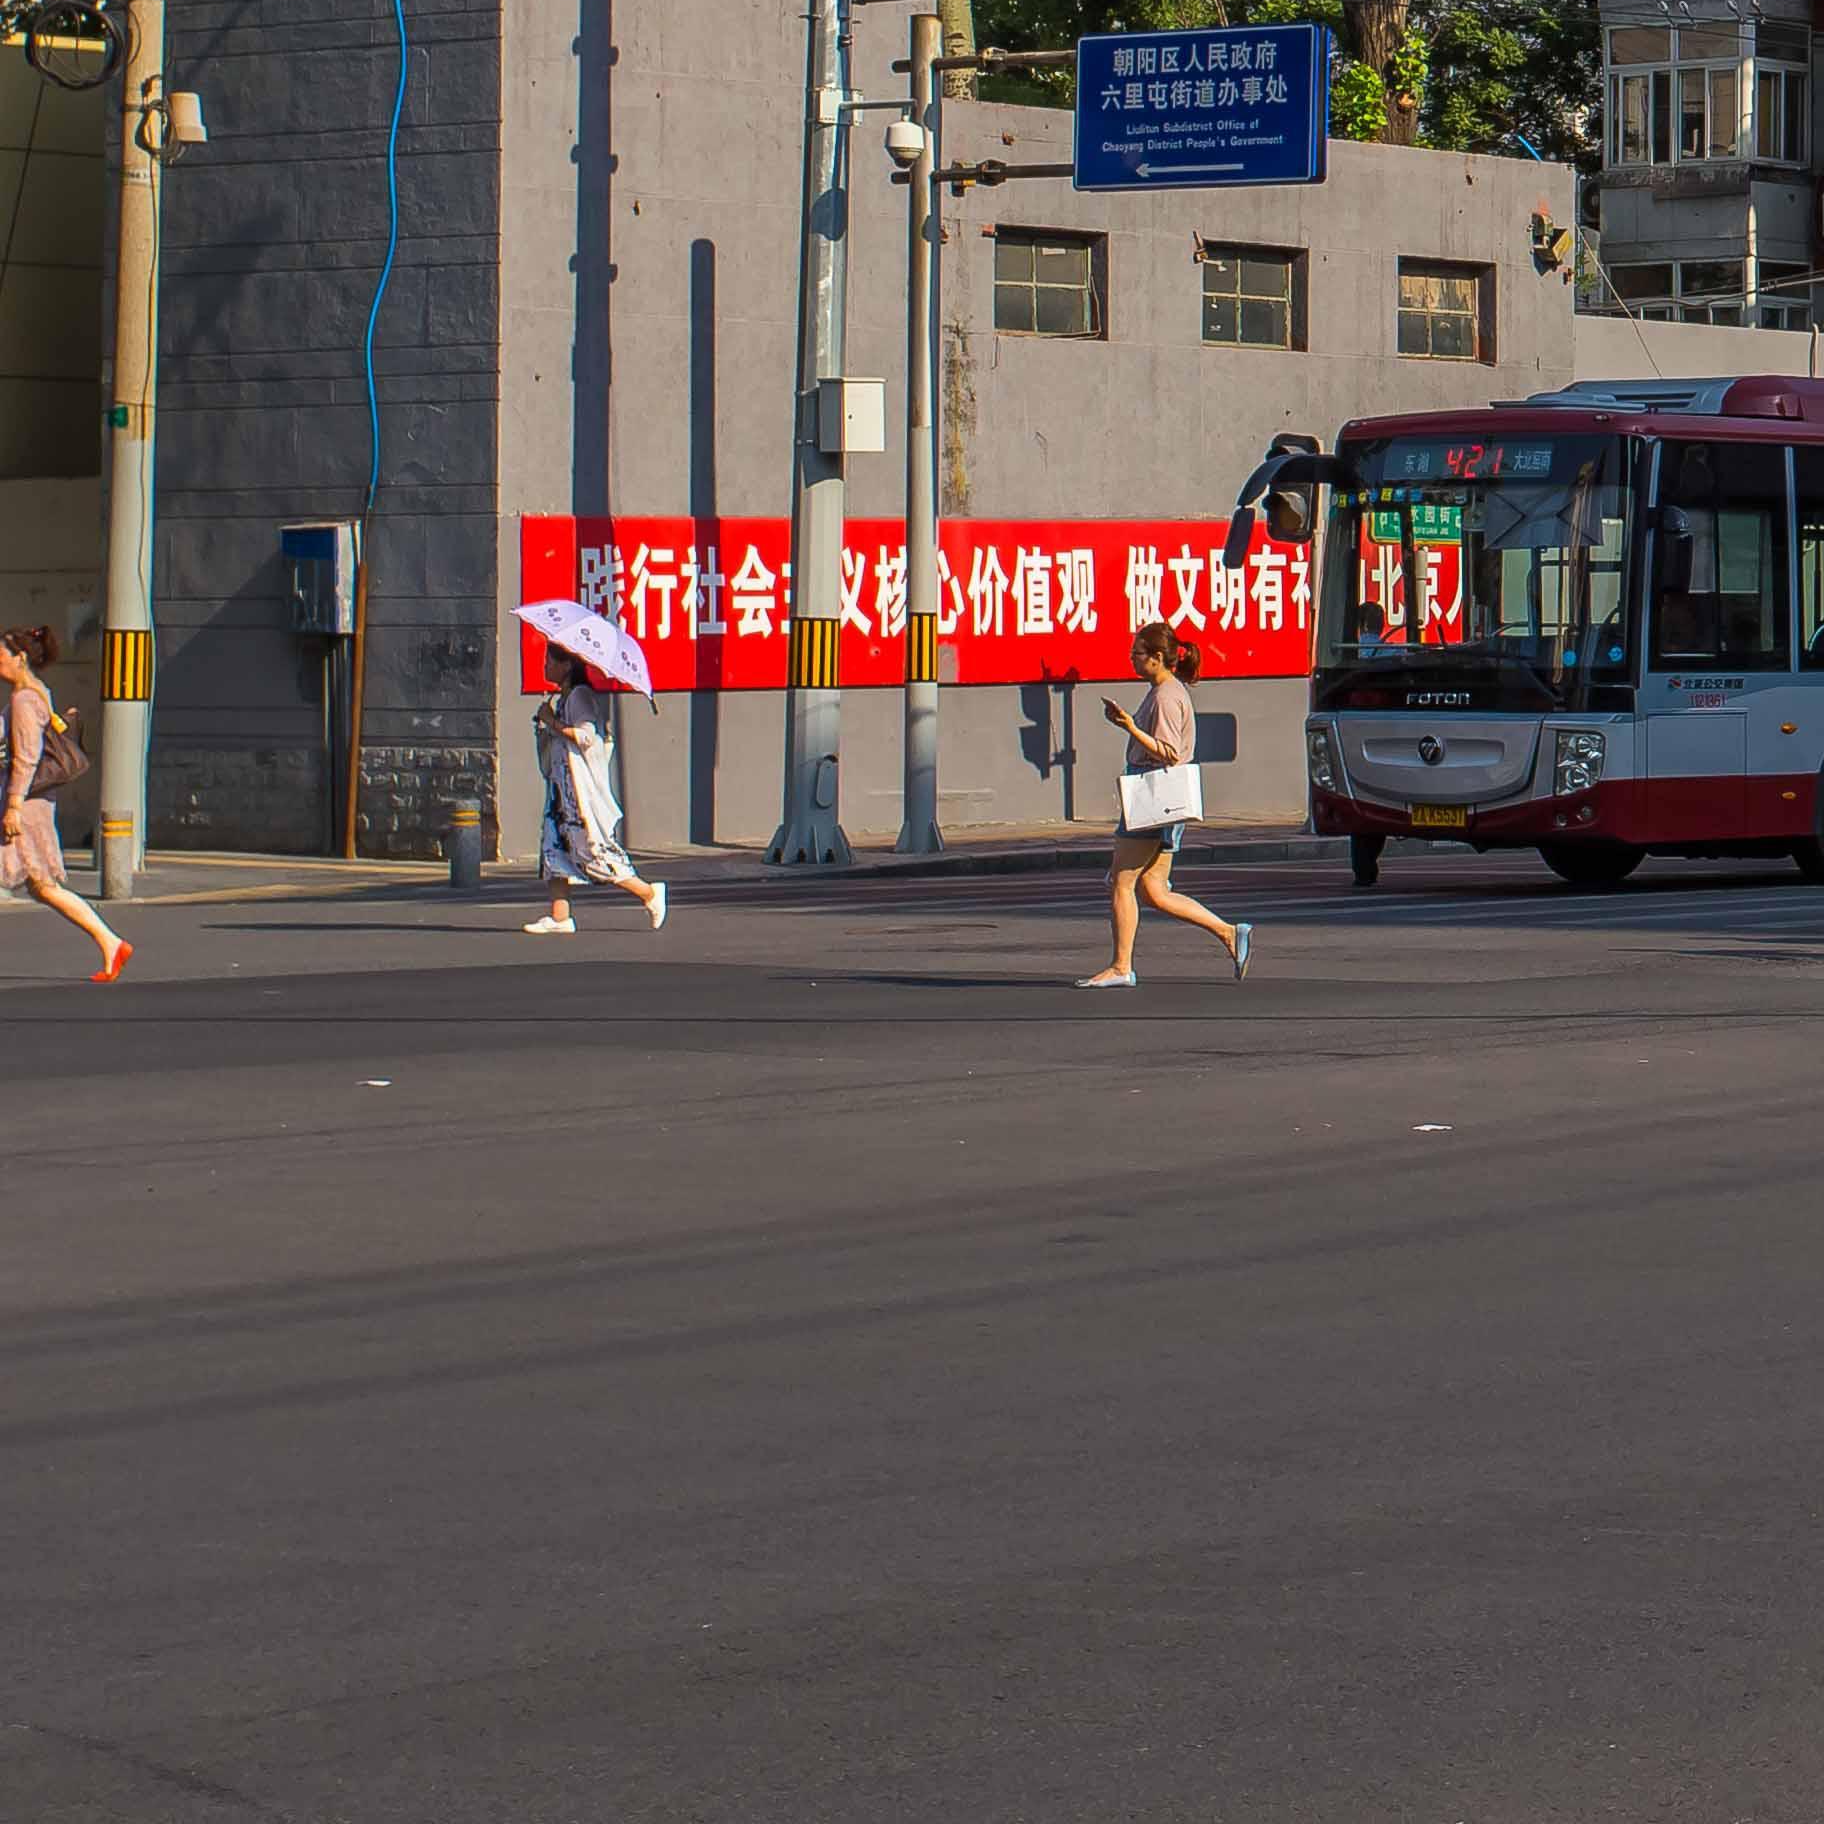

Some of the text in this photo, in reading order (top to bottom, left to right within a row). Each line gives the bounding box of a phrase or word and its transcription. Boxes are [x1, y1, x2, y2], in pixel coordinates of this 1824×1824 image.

[1112, 40, 1278, 78] 朝阳区人民政府
[1100, 74, 1289, 112] 六里屯街道办事处
[1102, 134, 1284, 153] Chaoyang District People's Government
[1126, 118, 1260, 136] Liulitun Subdistrict Office of
[1446, 444, 1504, 479] 421
[581, 542, 1098, 640] 践行社会义核心价值观
[1406, 692, 1471, 705] FOTON
